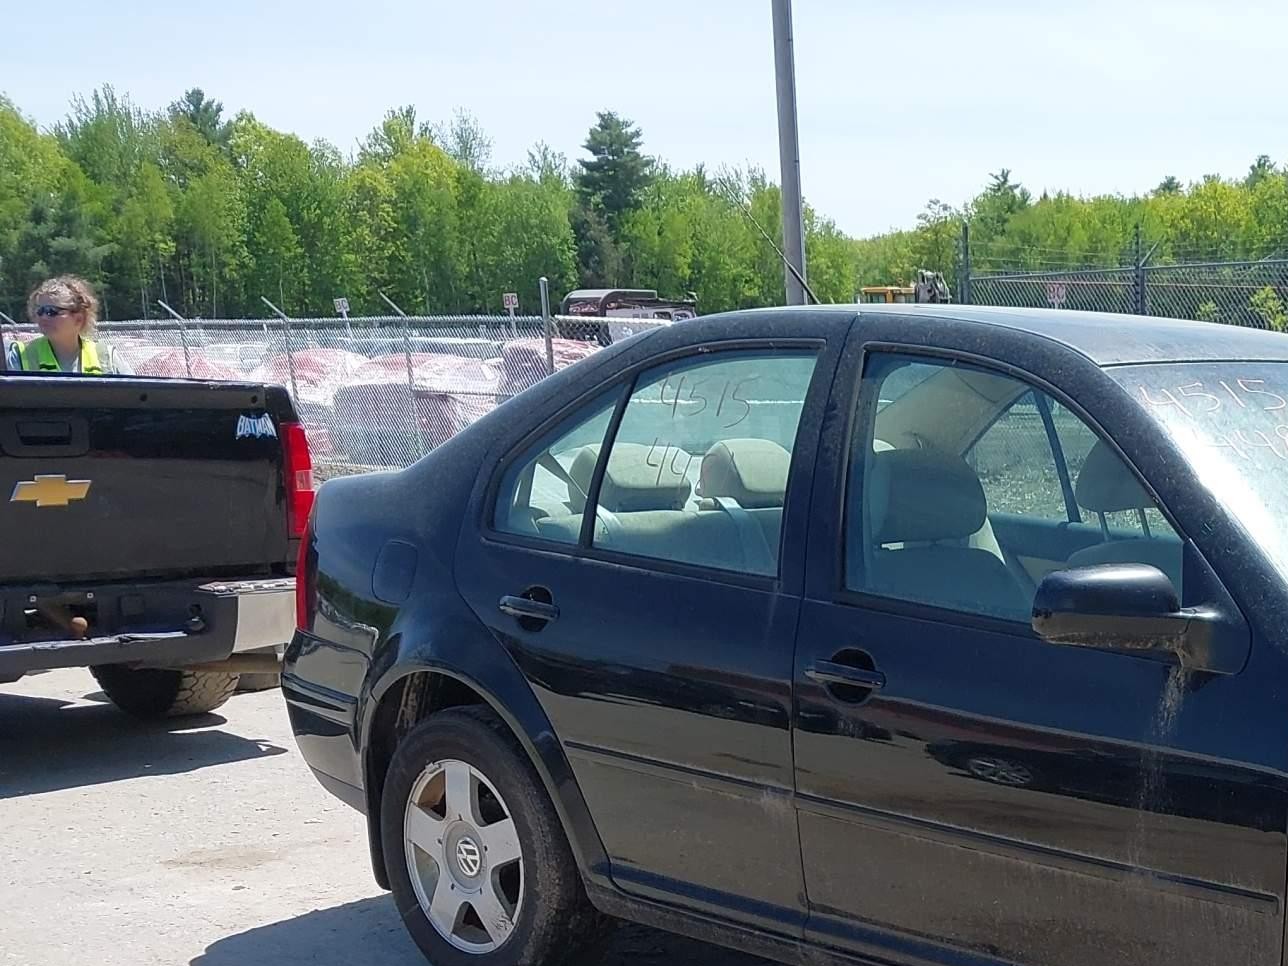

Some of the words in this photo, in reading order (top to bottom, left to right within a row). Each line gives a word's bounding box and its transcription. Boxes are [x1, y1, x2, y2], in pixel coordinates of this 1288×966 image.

[335, 299, 348, 310] BC
[505, 295, 517, 305] BC
[660, 374, 761, 429] 4515
[1138, 379, 1287, 420] 4515
[236, 412, 278, 440] BATMAN
